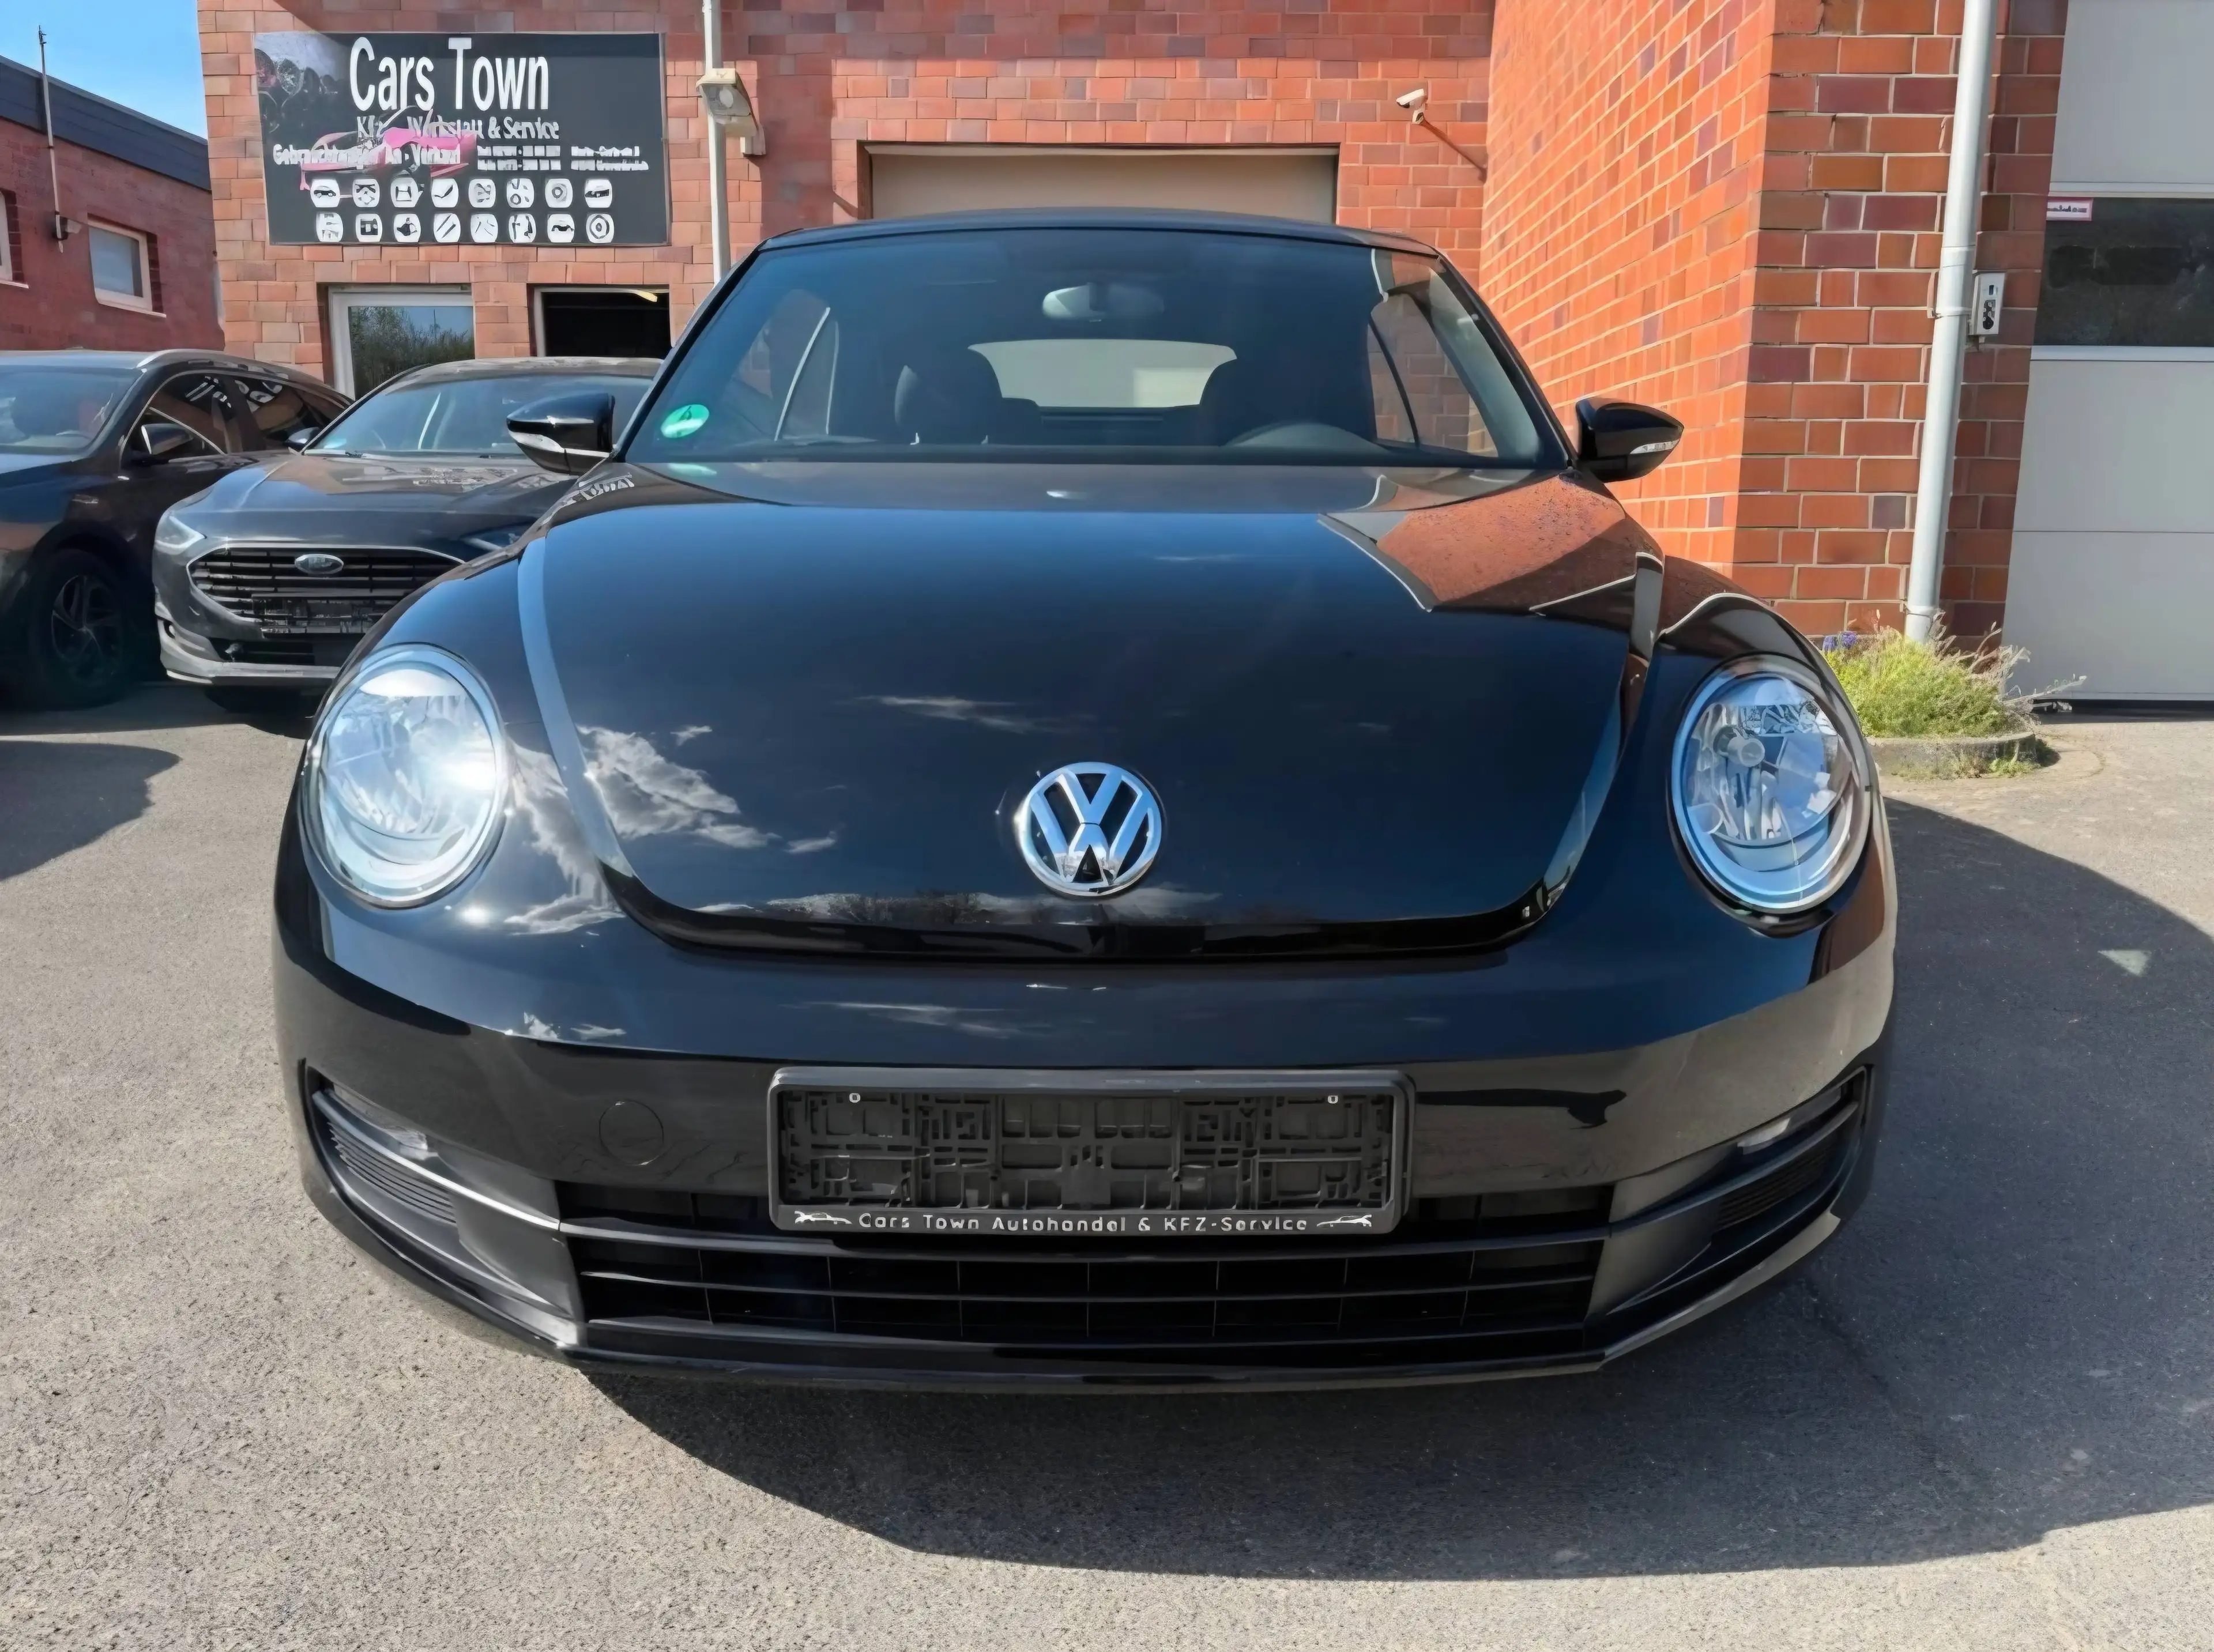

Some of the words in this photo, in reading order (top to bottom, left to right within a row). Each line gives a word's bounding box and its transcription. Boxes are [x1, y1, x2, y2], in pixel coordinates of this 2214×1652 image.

[349, 36, 435, 111] Cars
[448, 37, 549, 110] Town
[488, 116, 502, 139] &
[859, 1212, 910, 1228] Cars
[922, 1214, 979, 1230] Town
[991, 1216, 1125, 1232] Autohandel
[1138, 1217, 1151, 1232] &
[1164, 1216, 1308, 1232] KFZ-Service
